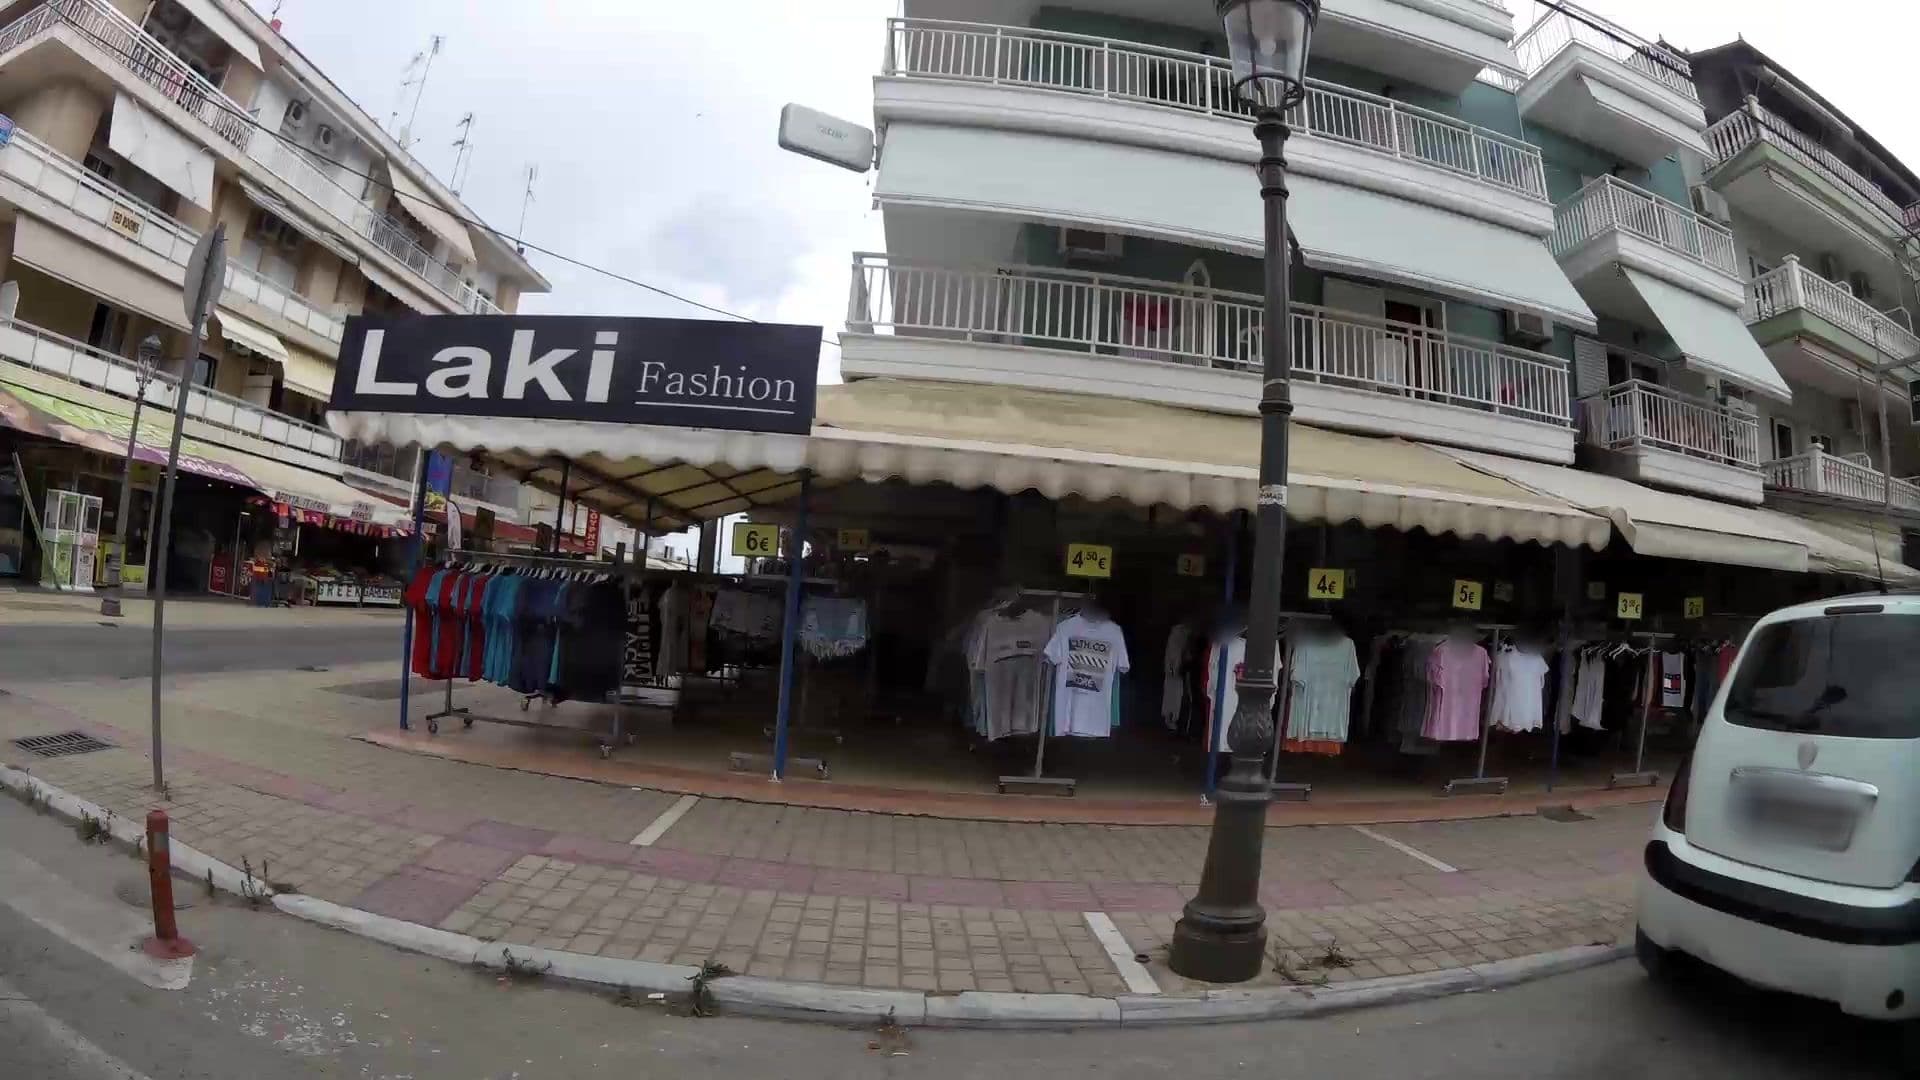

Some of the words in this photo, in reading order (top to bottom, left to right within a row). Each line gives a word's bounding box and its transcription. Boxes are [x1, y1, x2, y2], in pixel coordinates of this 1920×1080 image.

[355, 329, 619, 403] Laki
[636, 361, 796, 403] Fashion
[746, 530, 769, 551] 6€
[1316, 574, 1337, 594] 4€
[1460, 584, 1475, 604] 5€
